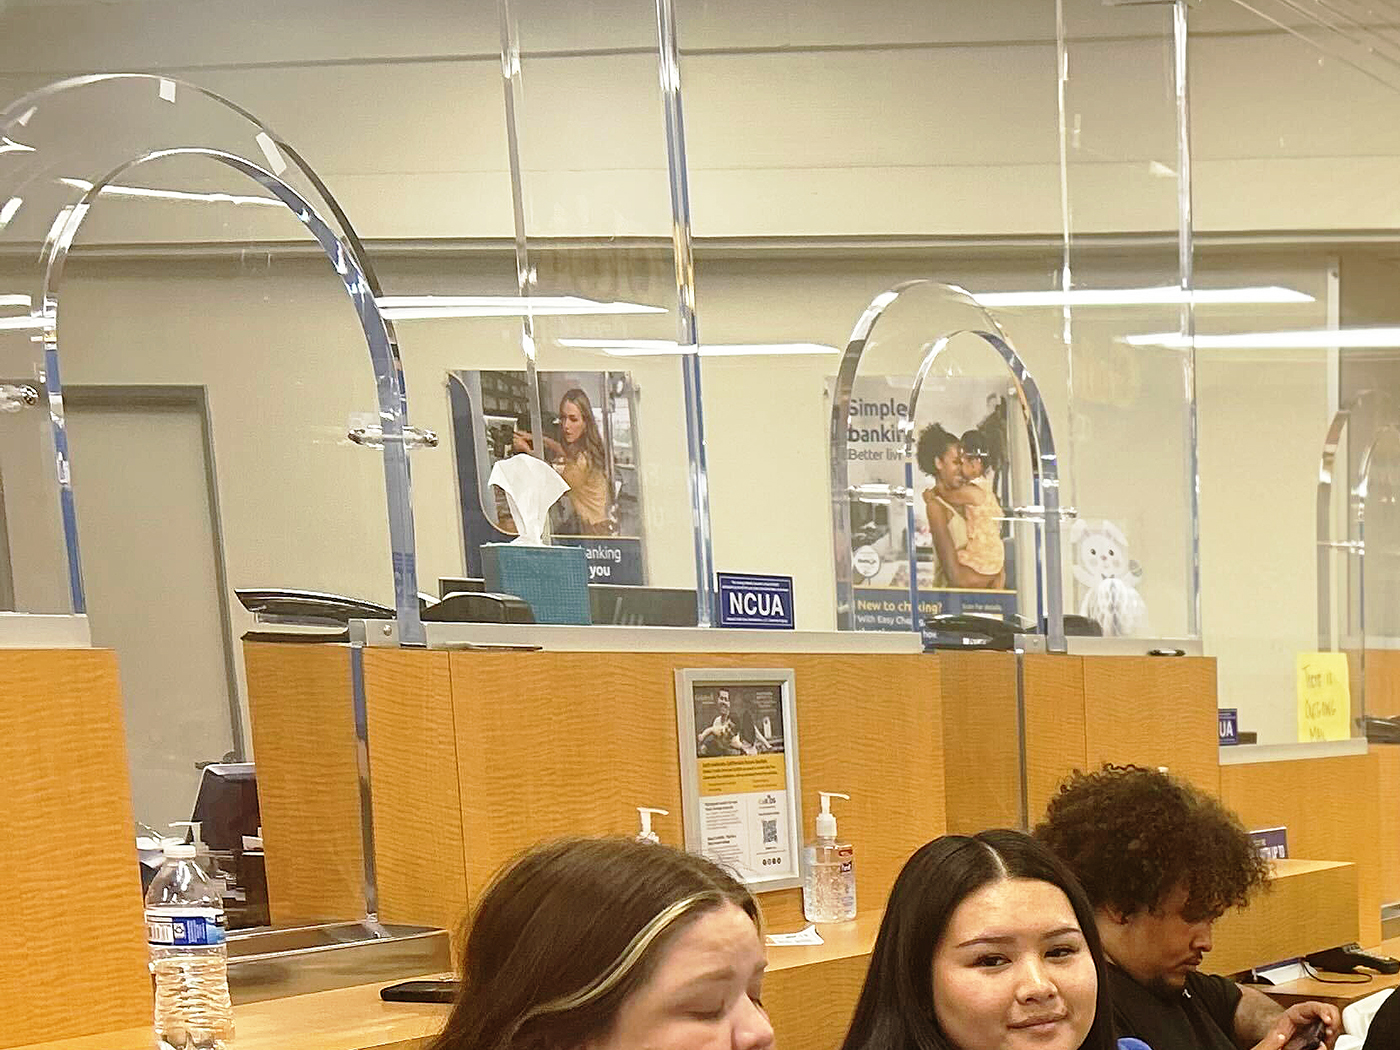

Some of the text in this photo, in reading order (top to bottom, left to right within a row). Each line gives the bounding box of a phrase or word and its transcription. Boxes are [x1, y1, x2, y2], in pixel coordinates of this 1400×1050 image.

[849, 398, 908, 420] Simple
[849, 422, 911, 443] bankin
[849, 449, 885, 461] Better
[582, 545, 622, 563] anking
[590, 566, 611, 579] you
[729, 591, 785, 616] NCUA
[857, 600, 880, 611] New
[883, 601, 896, 611] to
[1219, 720, 1234, 737] UA
